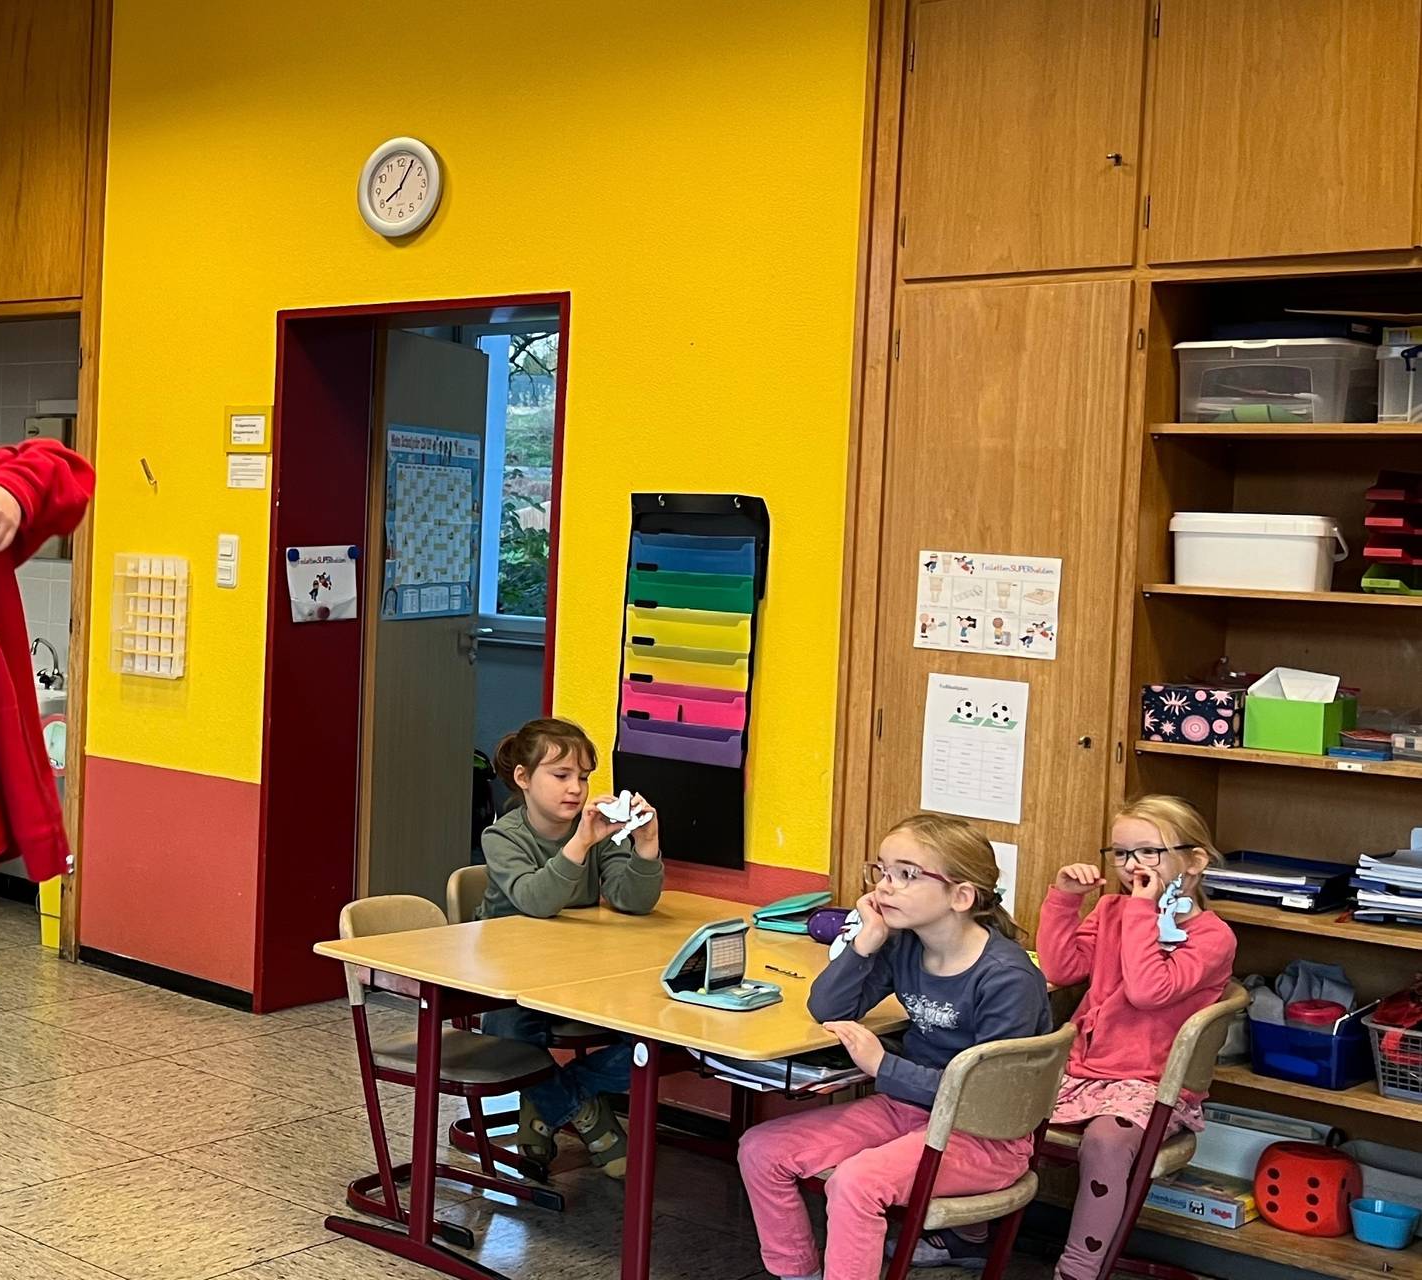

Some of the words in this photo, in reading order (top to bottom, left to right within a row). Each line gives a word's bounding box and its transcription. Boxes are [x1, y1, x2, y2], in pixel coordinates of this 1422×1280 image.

[397, 158, 405, 167] 12
[387, 164, 393, 172] 11
[417, 167, 423, 176] 2
[379, 174, 386, 183] 10
[421, 179, 426, 188] 3
[376, 188, 381, 196] 9
[418, 192, 423, 200] 4
[380, 199, 385, 208] 8
[409, 203, 414, 212] 5
[387, 207, 392, 216] 7
[398, 210, 403, 218] 6
